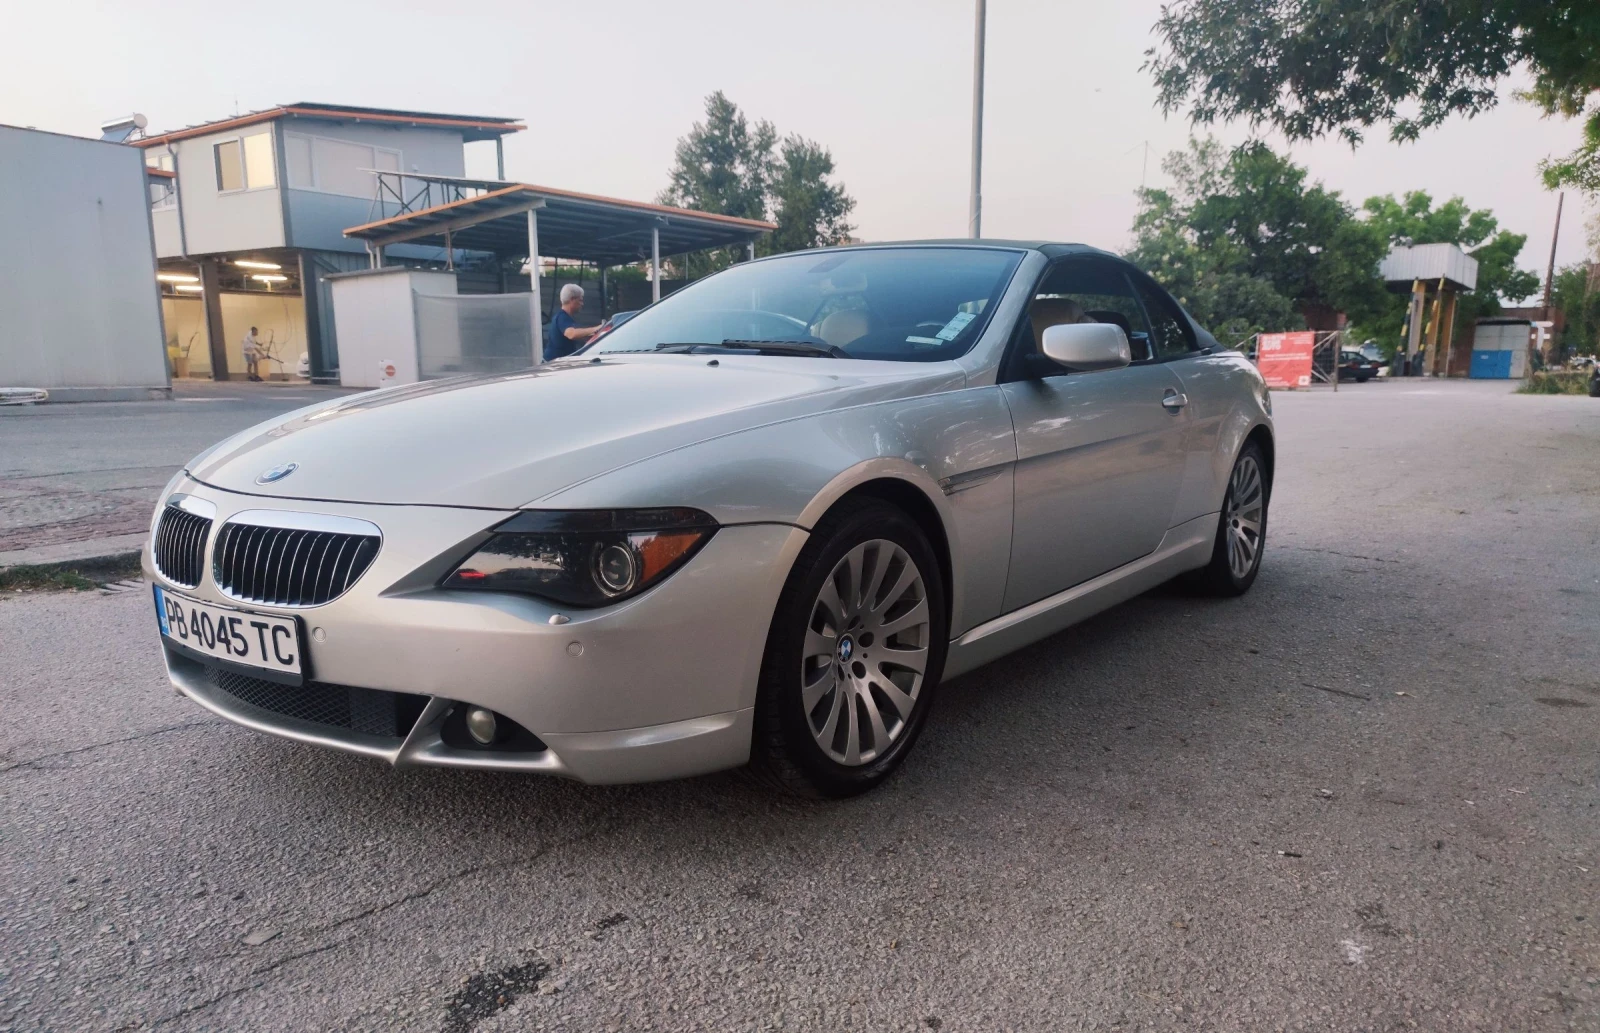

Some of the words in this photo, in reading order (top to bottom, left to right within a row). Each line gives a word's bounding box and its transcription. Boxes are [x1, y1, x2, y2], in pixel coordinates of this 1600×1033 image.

[164, 596, 188, 640] PB
[191, 608, 249, 657] 4045
[250, 620, 294, 666] TC
